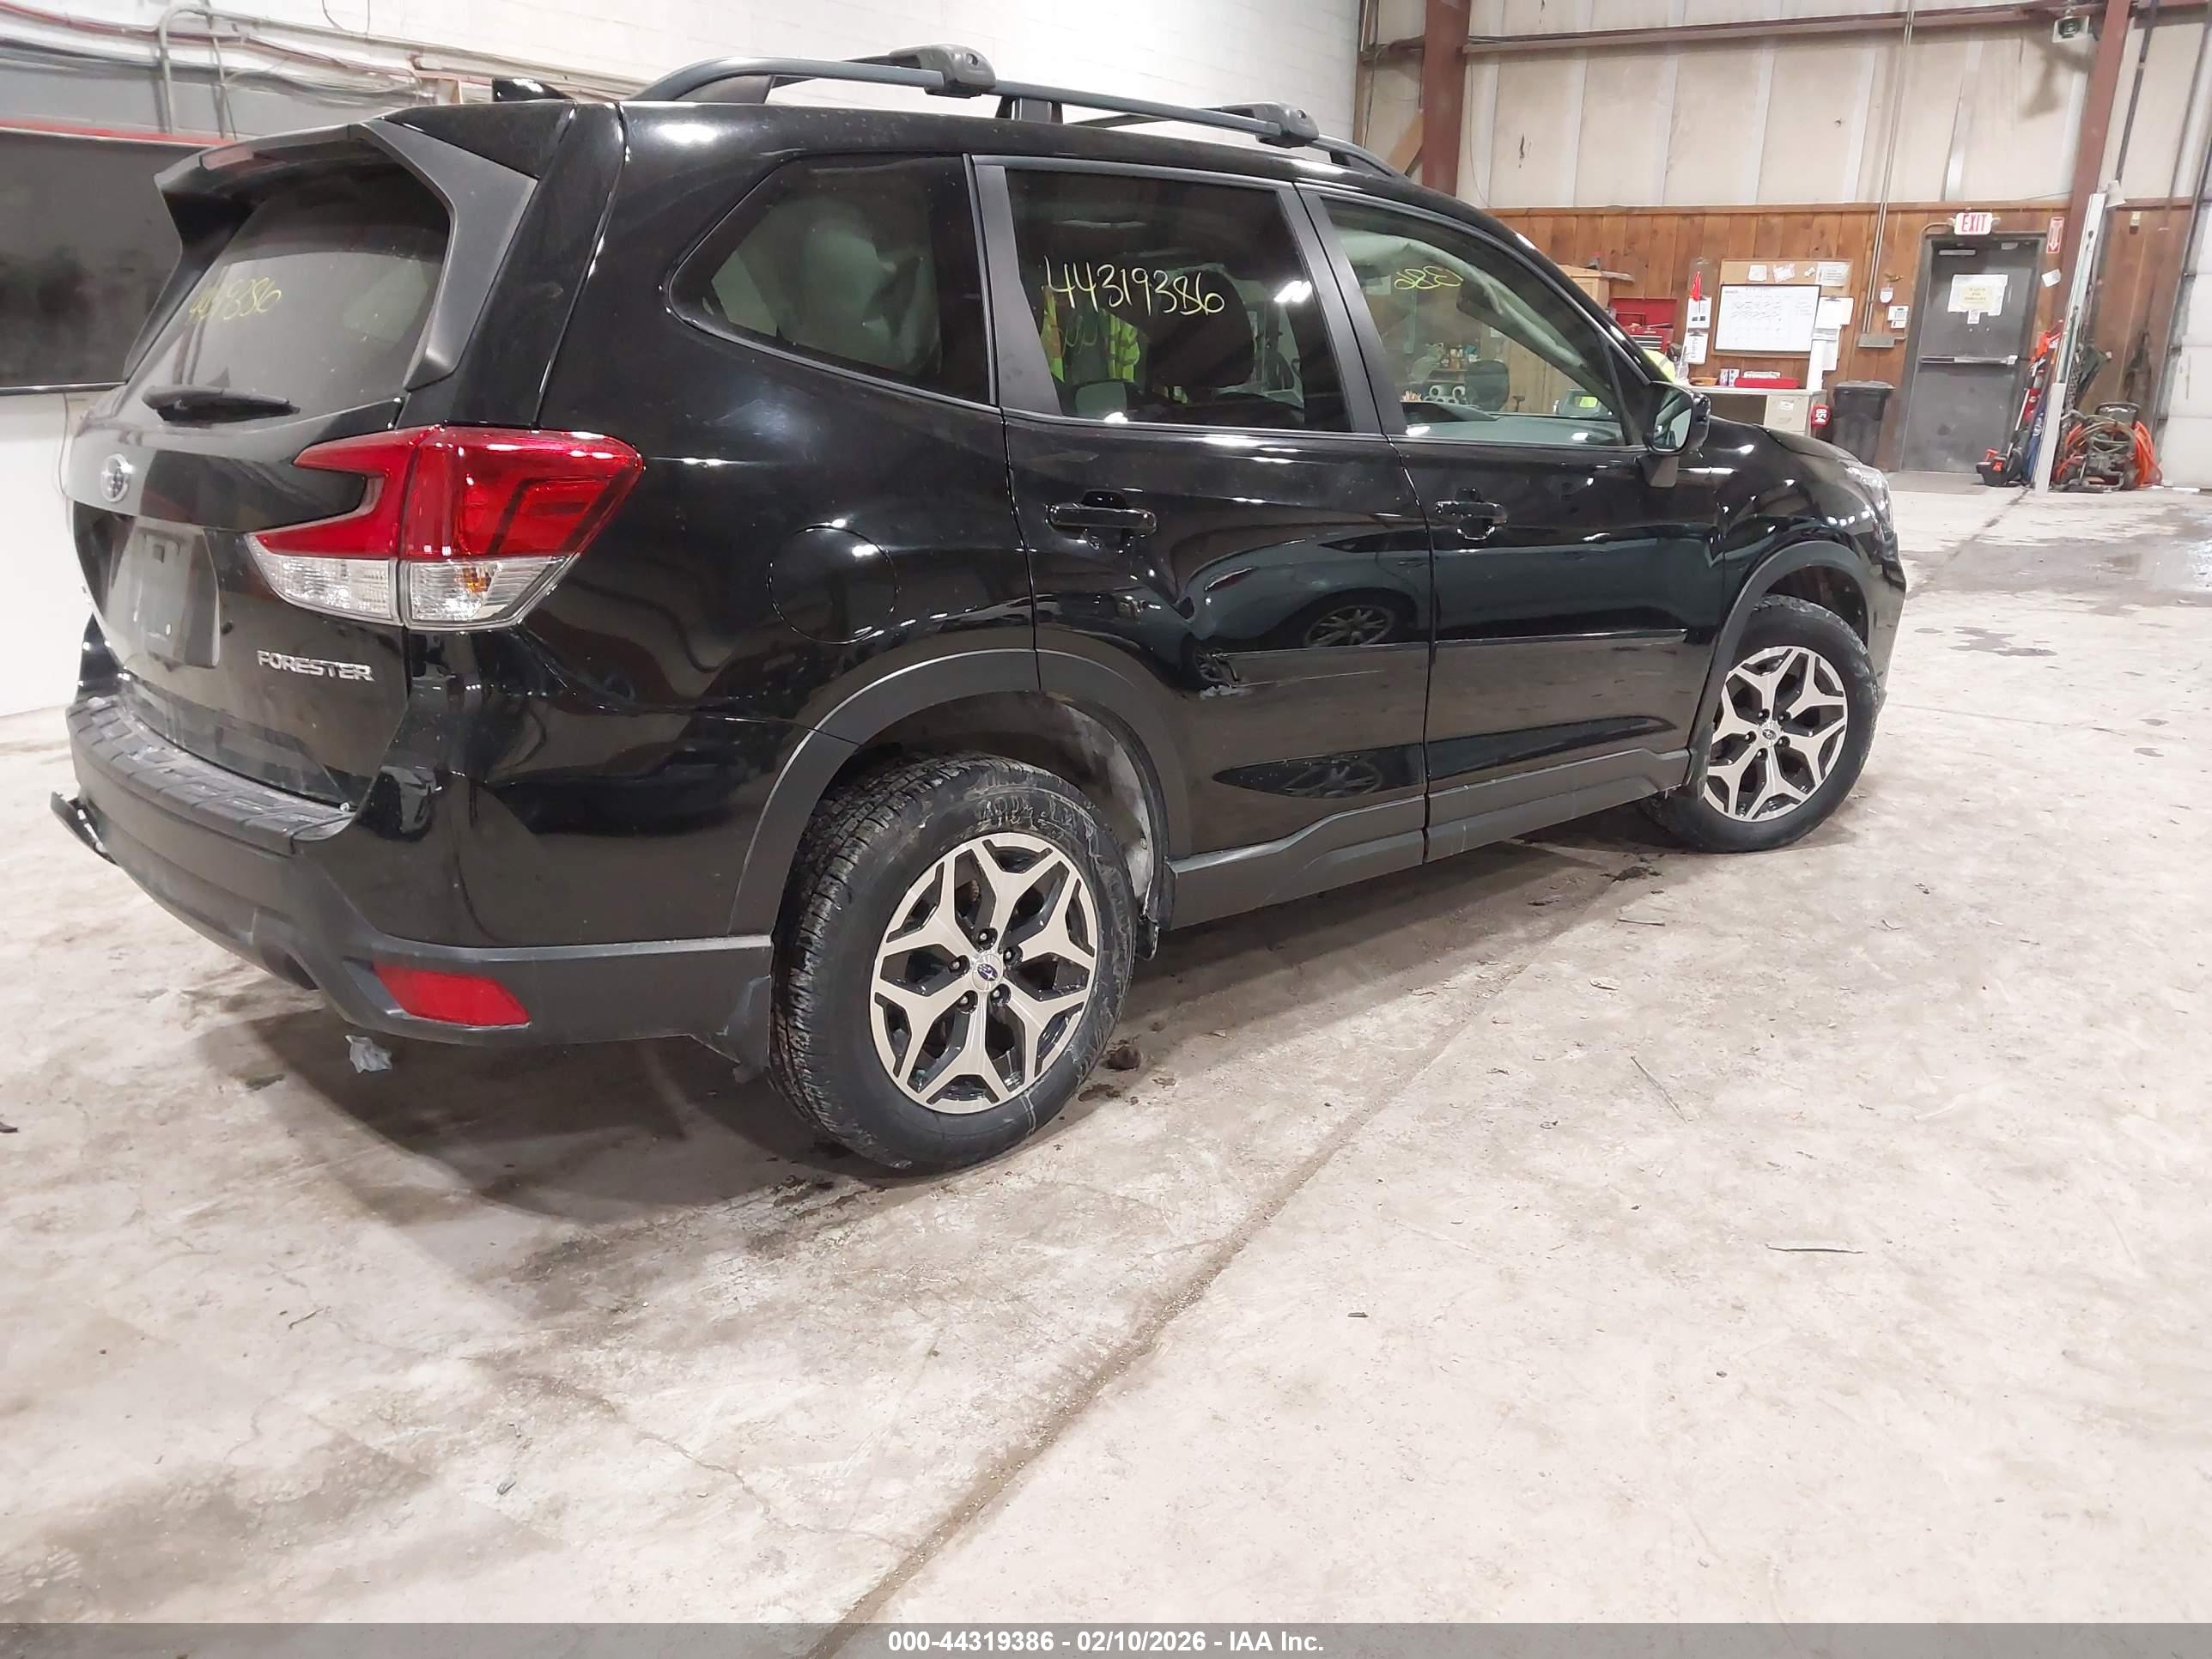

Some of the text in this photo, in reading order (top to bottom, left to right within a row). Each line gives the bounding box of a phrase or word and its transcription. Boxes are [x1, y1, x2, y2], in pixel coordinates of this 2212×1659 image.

[1961, 214, 1987, 232] EXIT
[1041, 255, 1225, 317] 44319386
[257, 649, 375, 681] FORESTER
